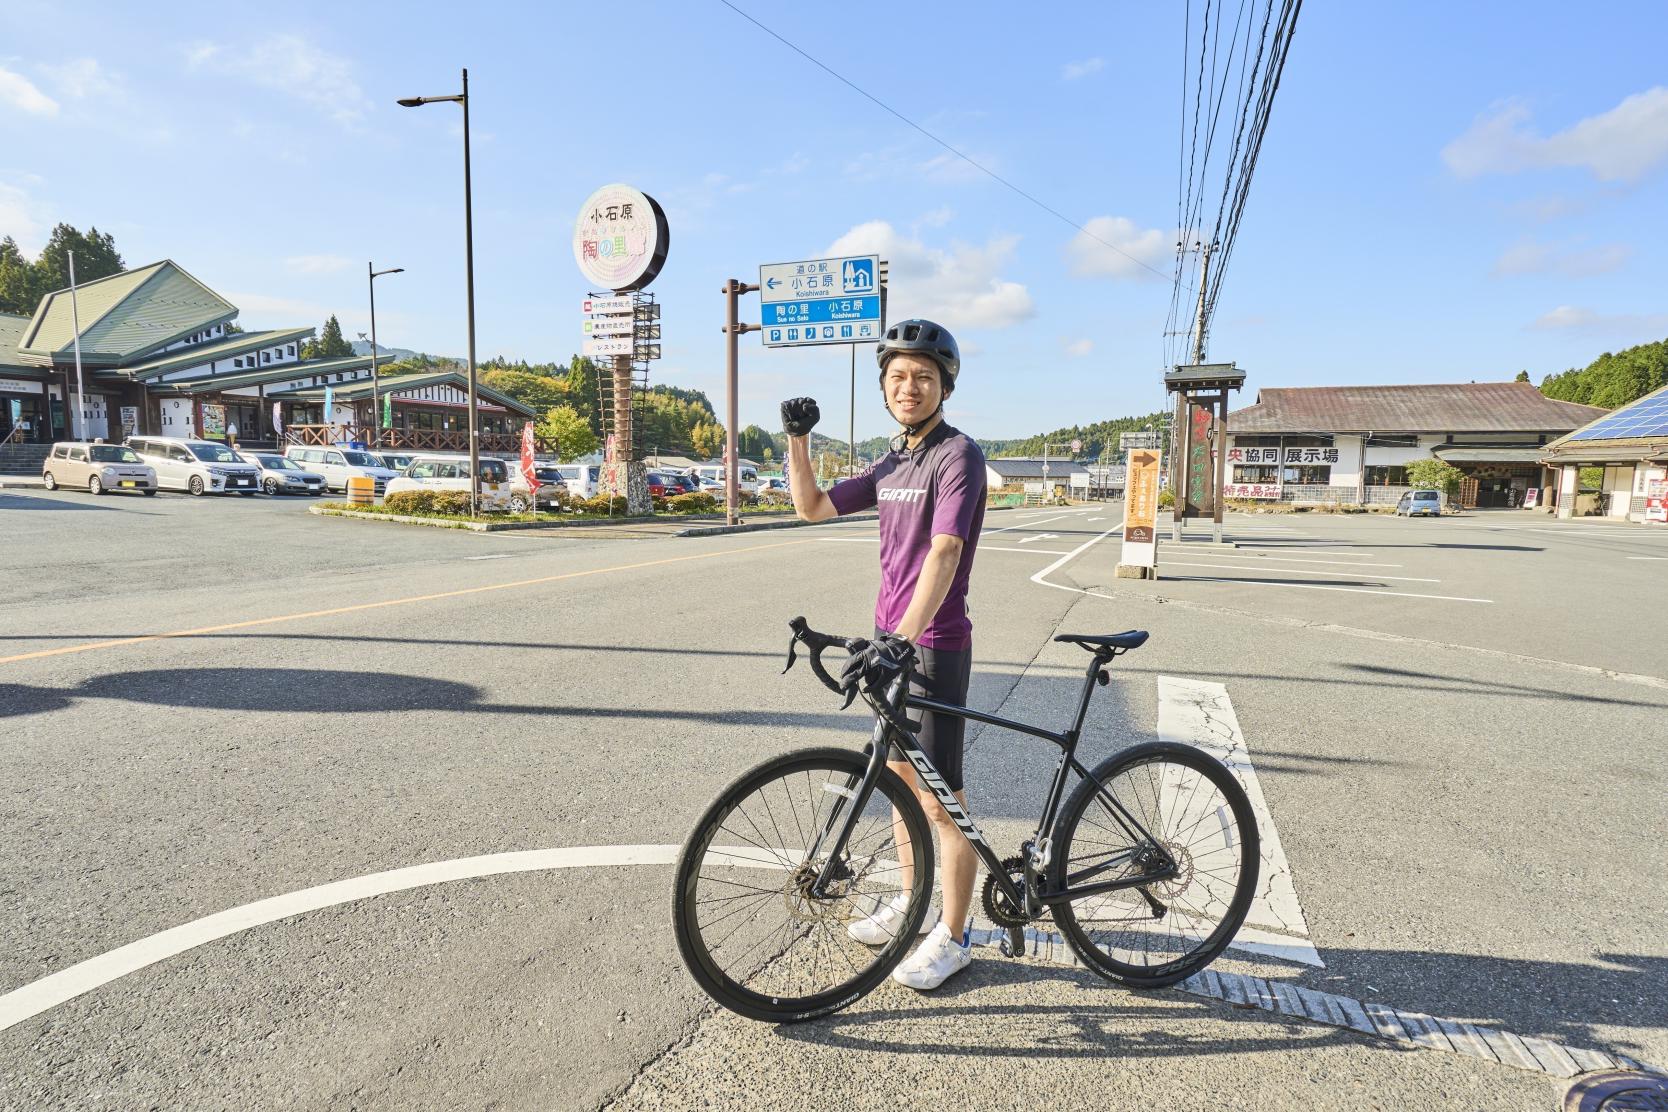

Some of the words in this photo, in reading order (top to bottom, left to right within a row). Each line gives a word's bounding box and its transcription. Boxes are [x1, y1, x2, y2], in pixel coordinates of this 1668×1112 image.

[590, 203, 633, 224] 小石原
[796, 262, 828, 275] 道の駅
[791, 274, 834, 290] 小石原
[796, 289, 829, 298] Koishiwara
[776, 303, 810, 316] 陶の里
[828, 299, 863, 312] 小石原
[597, 343, 629, 351] レストラン
[878, 487, 928, 503] GIANT
[903, 749, 990, 848] GIANT
[1102, 969, 1124, 981] GIANT
[834, 991, 861, 1009] GIANT
